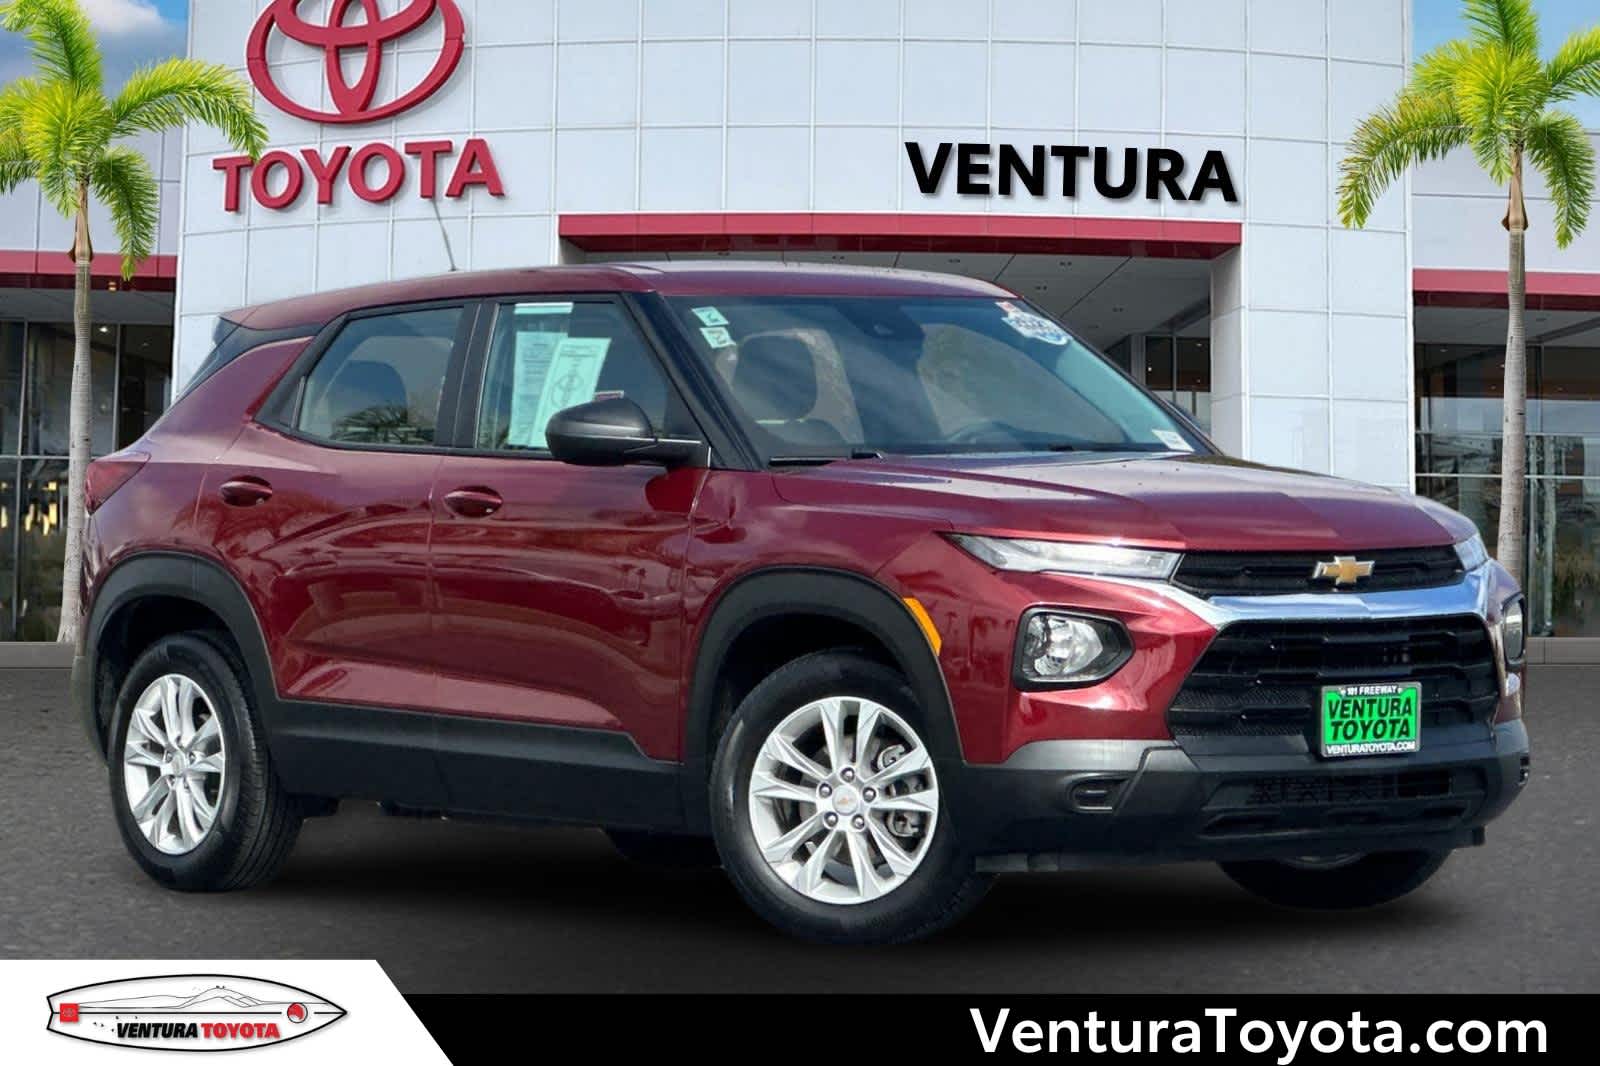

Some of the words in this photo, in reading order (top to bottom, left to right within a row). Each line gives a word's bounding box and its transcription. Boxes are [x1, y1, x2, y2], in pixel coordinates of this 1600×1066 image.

[212, 138, 505, 213] TOYOTA
[904, 141, 1239, 203] VENTURA
[1359, 685, 1397, 696] FREEWAY
[1328, 697, 1412, 719] VENTURA
[1330, 718, 1410, 741] TOYOTA
[1326, 741, 1416, 755] VENTURATOYOTA.COM
